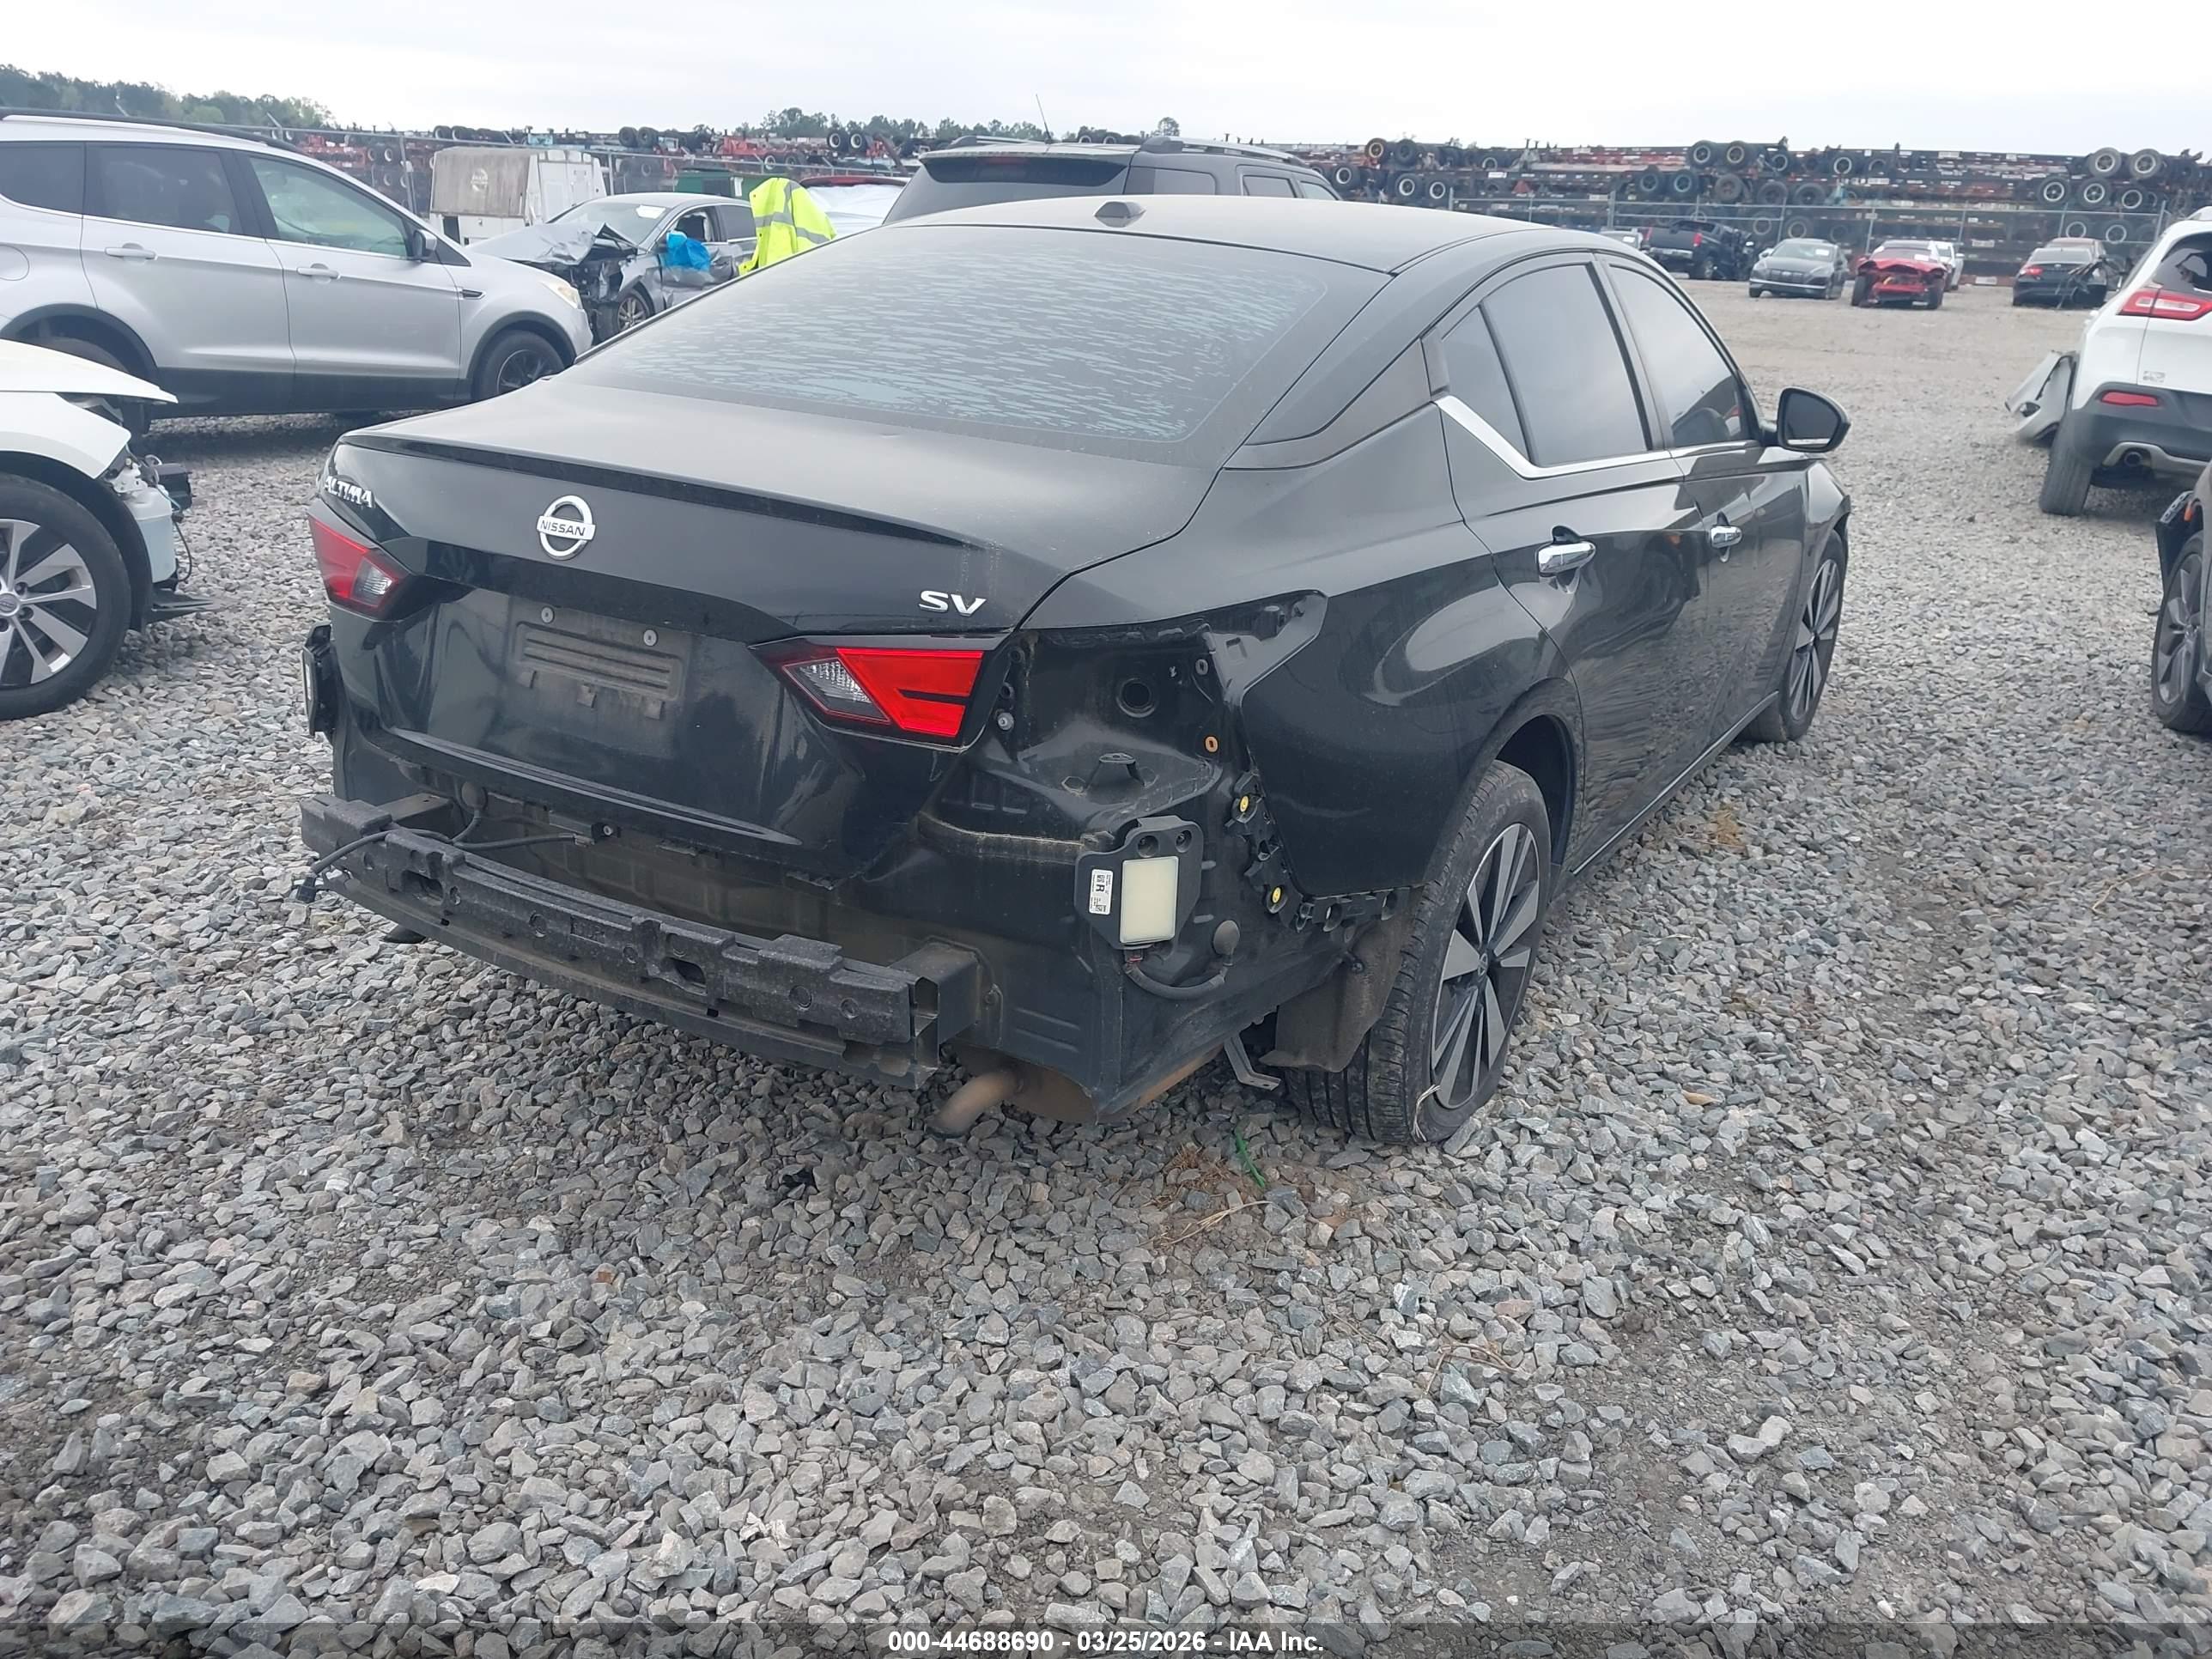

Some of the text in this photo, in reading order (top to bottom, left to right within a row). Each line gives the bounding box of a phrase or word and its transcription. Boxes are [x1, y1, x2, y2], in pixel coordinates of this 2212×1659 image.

[325, 476, 373, 508] ALTIMA
[540, 520, 586, 537] NISSAN
[918, 590, 987, 617] SV
[1095, 884, 1105, 892] R
